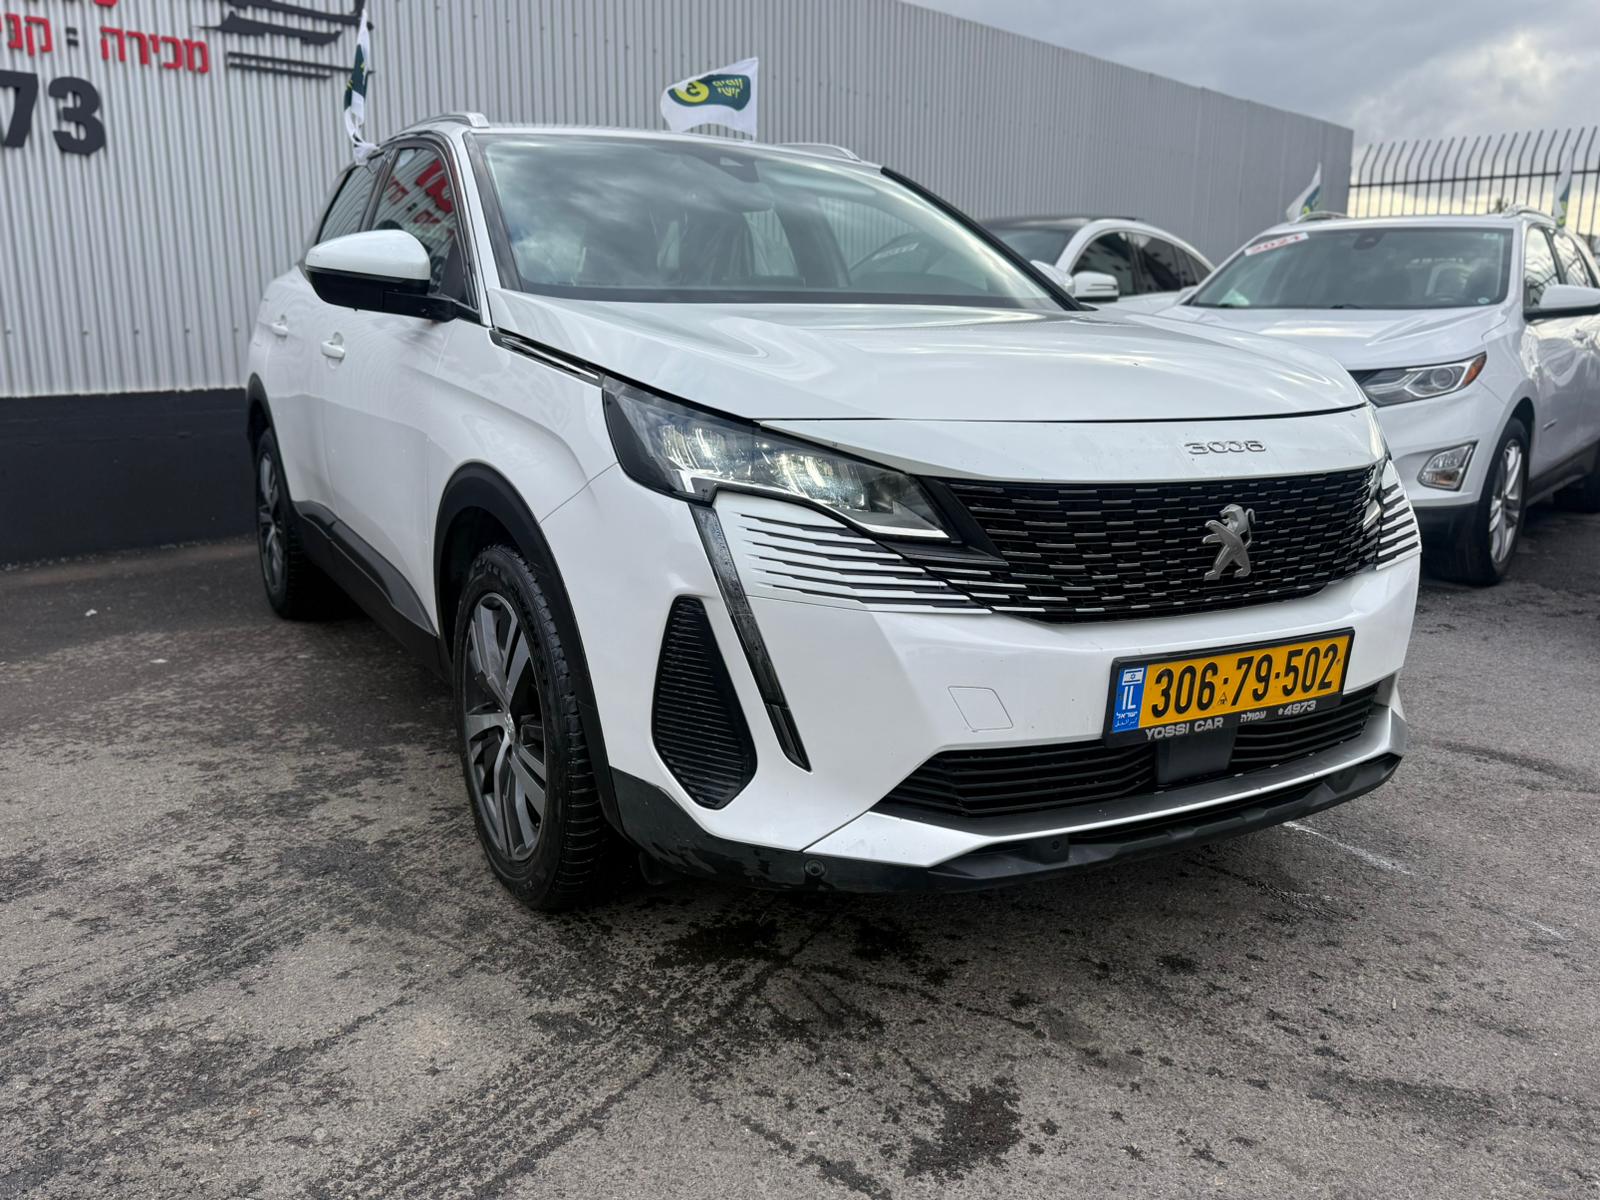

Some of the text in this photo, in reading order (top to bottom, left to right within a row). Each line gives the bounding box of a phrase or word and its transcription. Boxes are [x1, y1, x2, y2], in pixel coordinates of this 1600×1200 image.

[0, 13, 53, 57] קנ
[100, 26, 209, 74] מכירה
[0, 69, 107, 155] 73
[1184, 440, 1266, 455] 3008
[1122, 685, 1136, 710] IL
[1116, 711, 1138, 719] ישראל
[1145, 717, 1224, 741] YOSSI CAR
